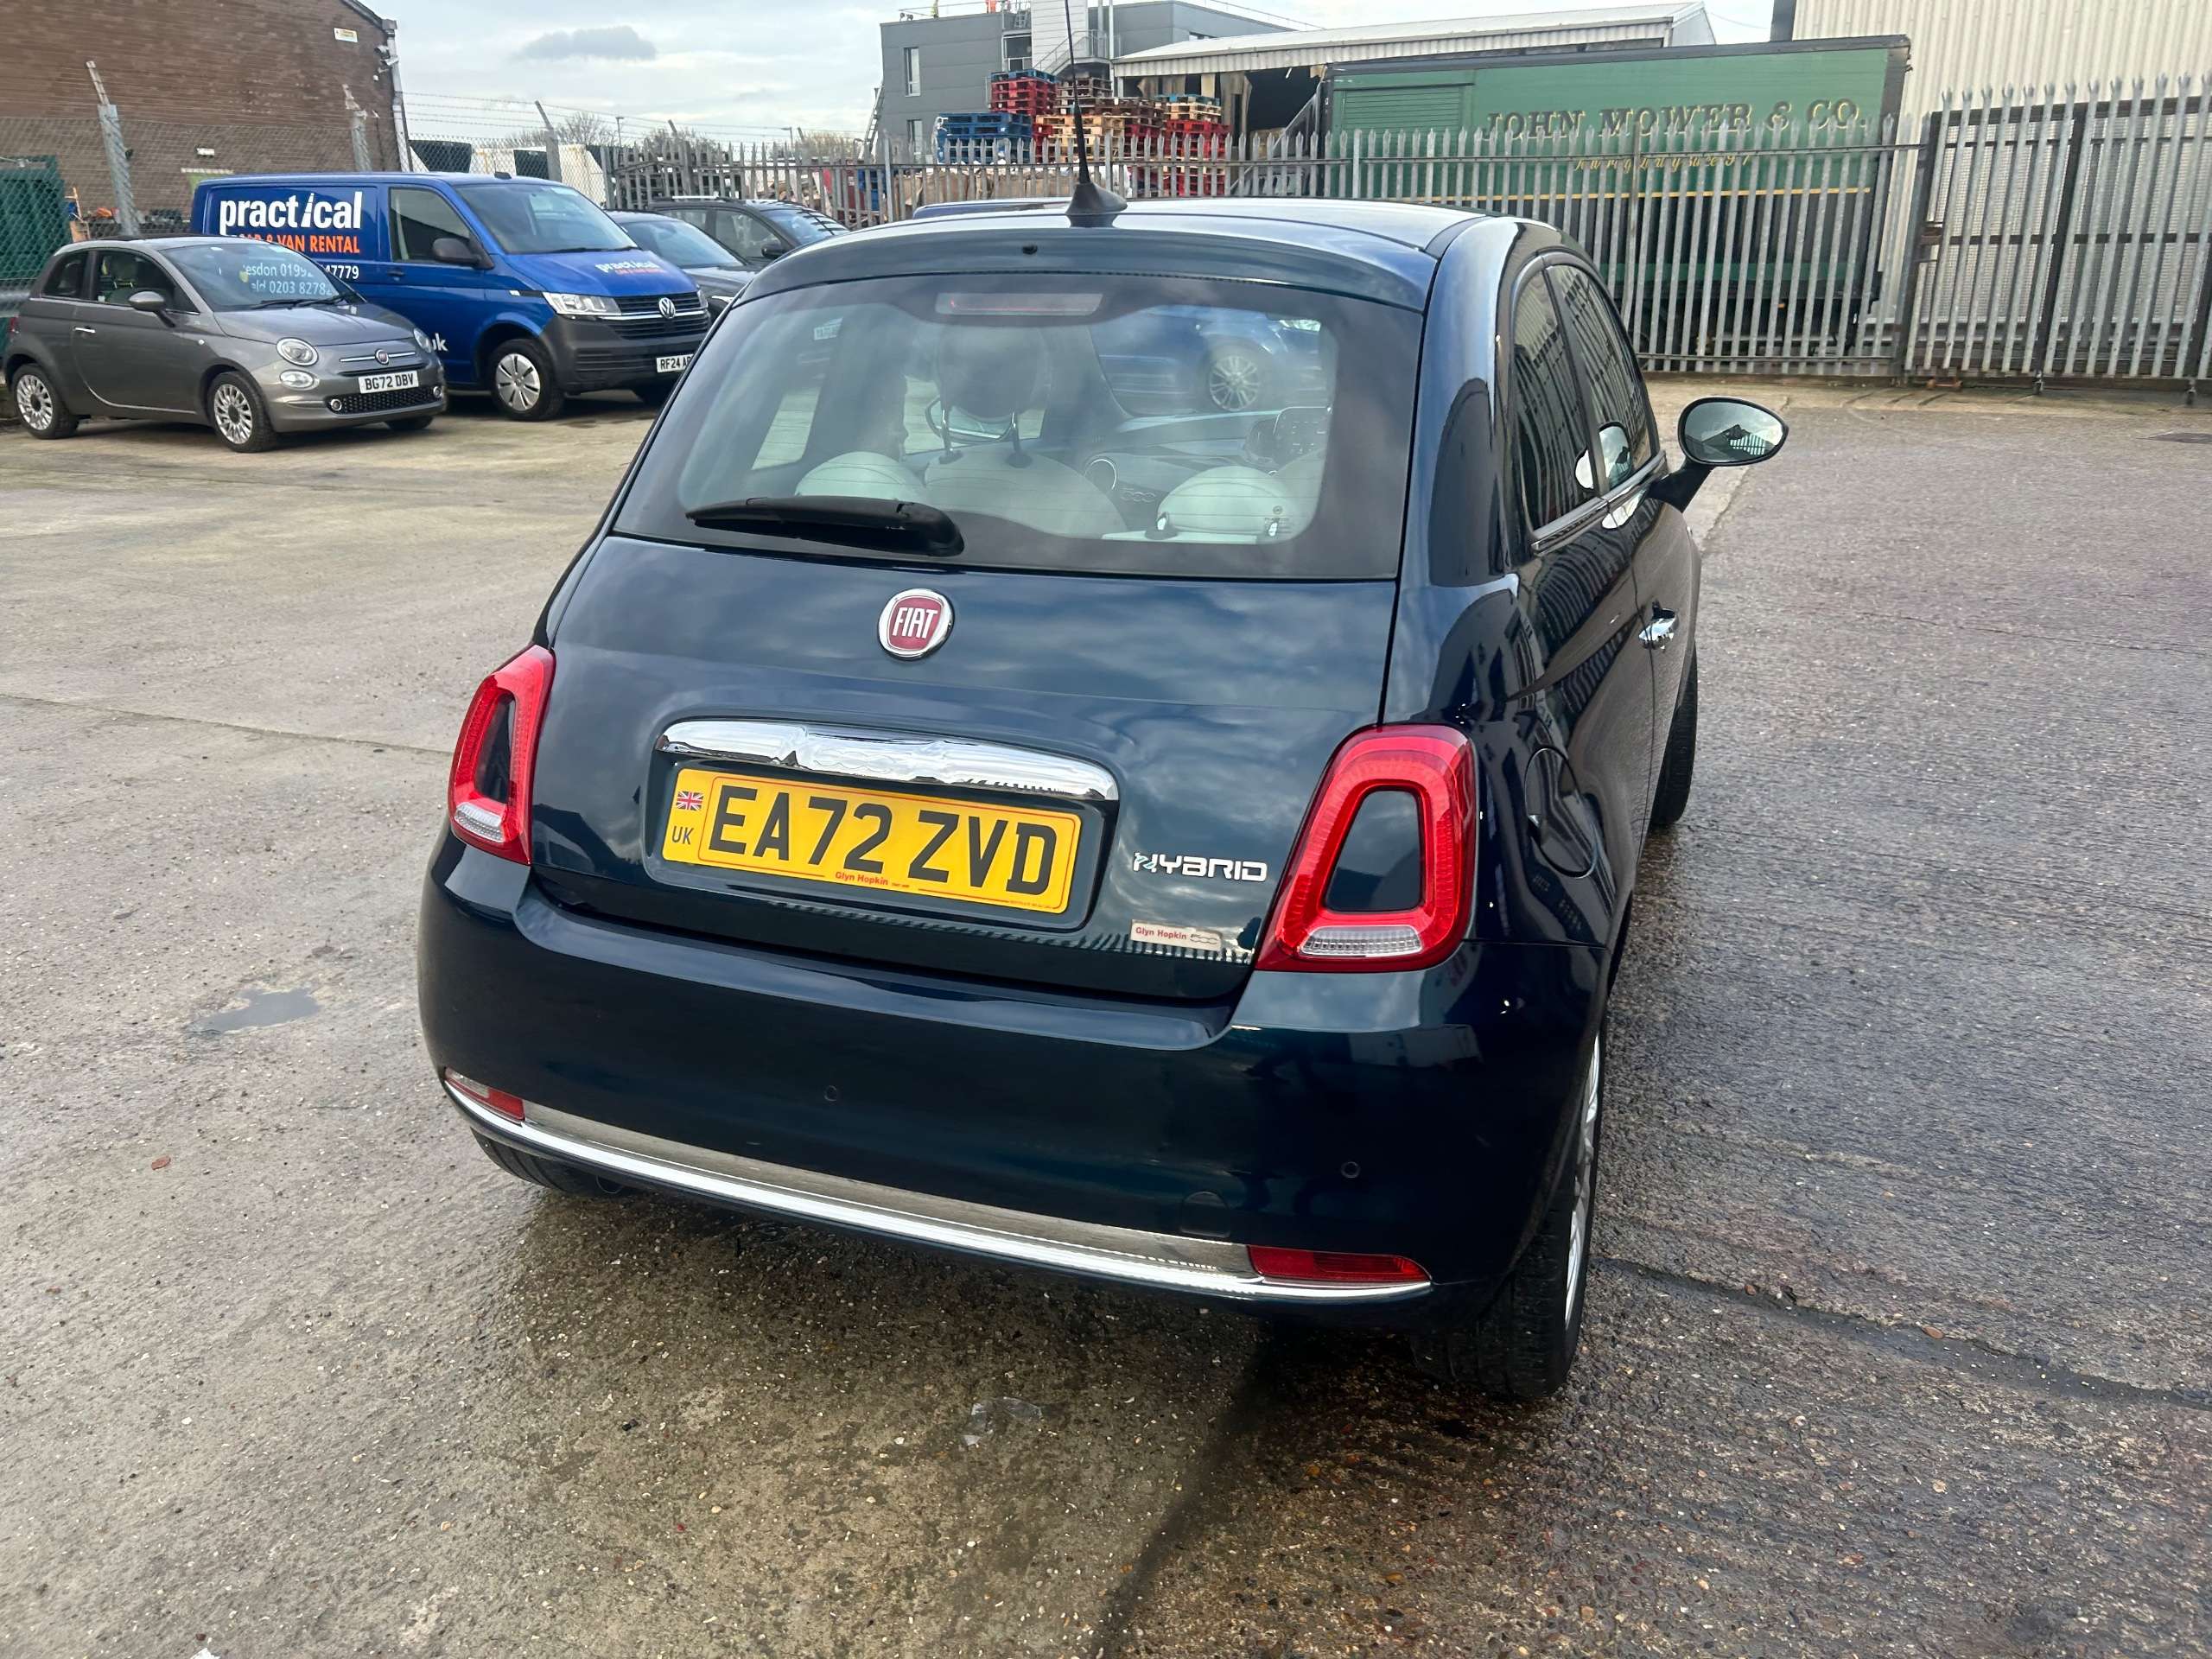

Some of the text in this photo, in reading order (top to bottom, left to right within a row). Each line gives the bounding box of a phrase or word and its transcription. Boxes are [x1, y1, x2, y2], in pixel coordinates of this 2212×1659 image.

[1483, 110, 1586, 141] JOHN
[1599, 103, 1753, 137] MOWER
[1764, 100, 1792, 130] &
[219, 191, 363, 236] practical
[276, 234, 305, 251] VAN
[309, 234, 360, 253] RENTAL
[269, 281, 296, 294] 0203
[660, 358, 681, 370] RF24
[365, 373, 413, 390] BG72 DBV
[892, 607, 938, 639] FIAT
[671, 825, 694, 845] UK
[709, 785, 1057, 895] EA72 ZVD
[1133, 852, 1268, 882] HYBRID
[835, 871, 855, 881] Glyn
[857, 874, 889, 886] Hopkin
[1135, 926, 1154, 936] Glyn
[1157, 929, 1187, 940] Hopkin
